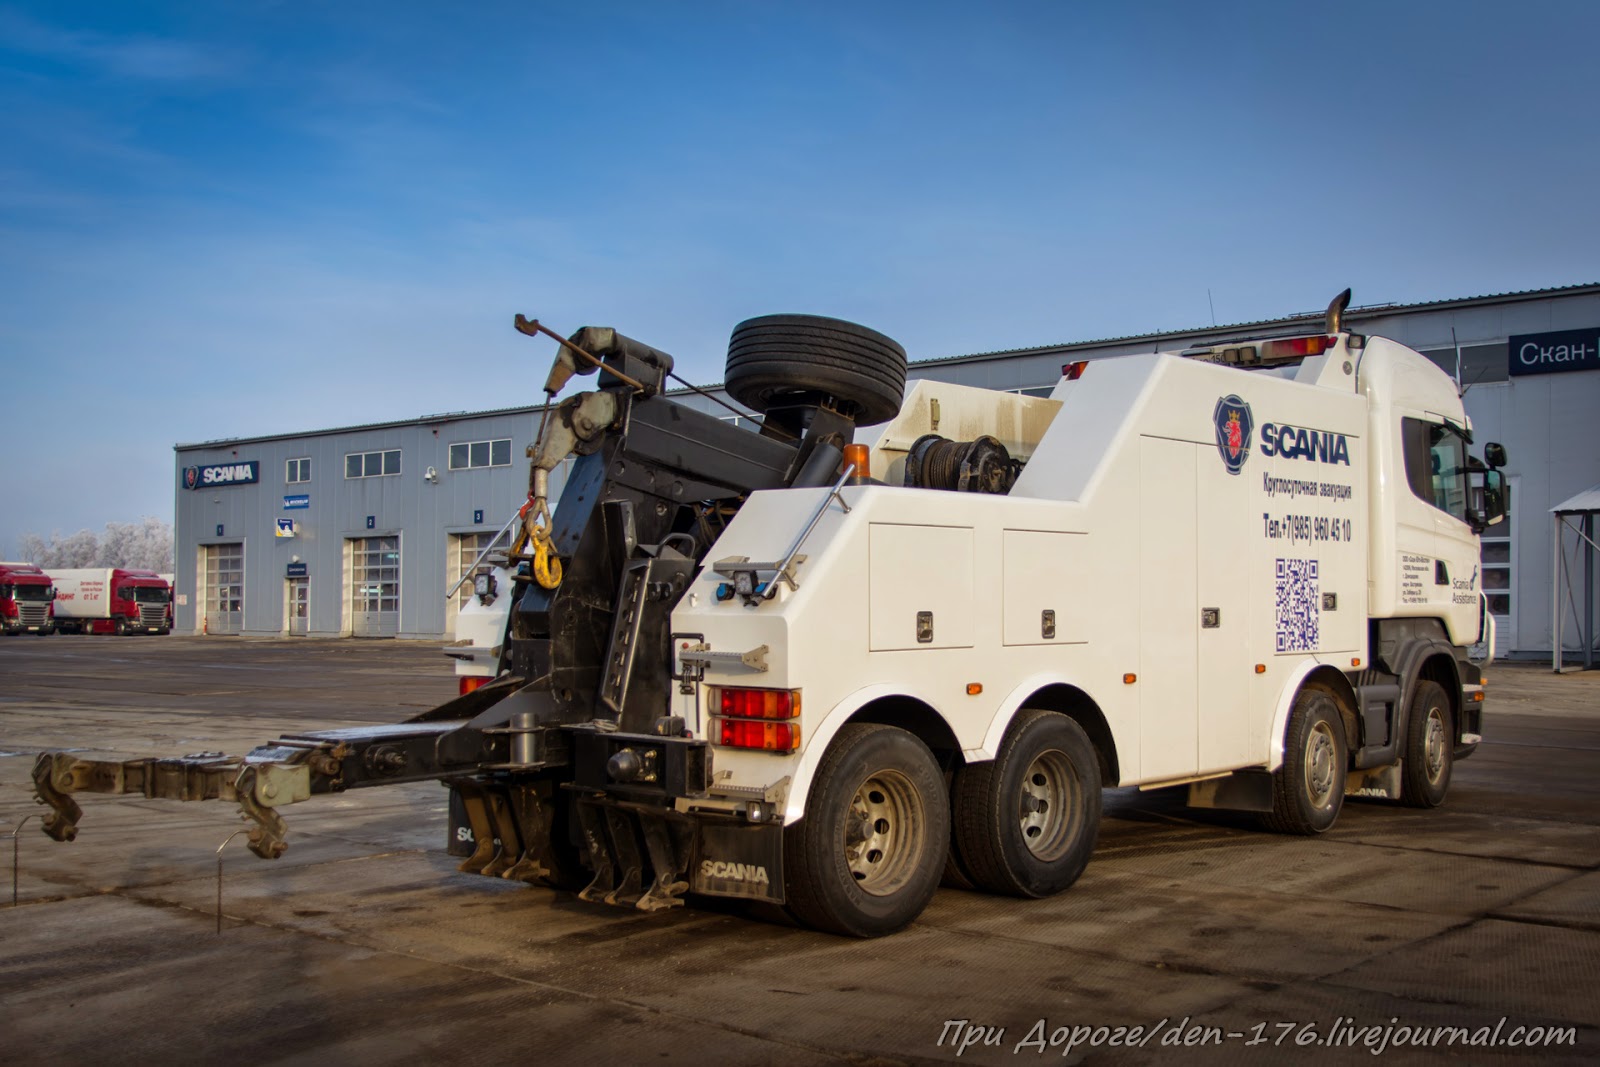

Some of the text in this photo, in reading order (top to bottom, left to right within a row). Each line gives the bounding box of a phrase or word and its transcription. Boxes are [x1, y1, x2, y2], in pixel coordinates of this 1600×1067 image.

[1520, 337, 1600, 365] Скан-
[1260, 423, 1350, 466] SCANIA
[203, 464, 253, 483] SCANIA
[1263, 471, 1352, 502] Круглосуточная эвакуация
[1314, 517, 1329, 541] 960
[1331, 518, 1340, 541] 45
[1343, 519, 1351, 542] 10
[1453, 577, 1469, 590] Scania
[1452, 592, 1476, 604] Assistance
[701, 860, 769, 884] SCANIA
